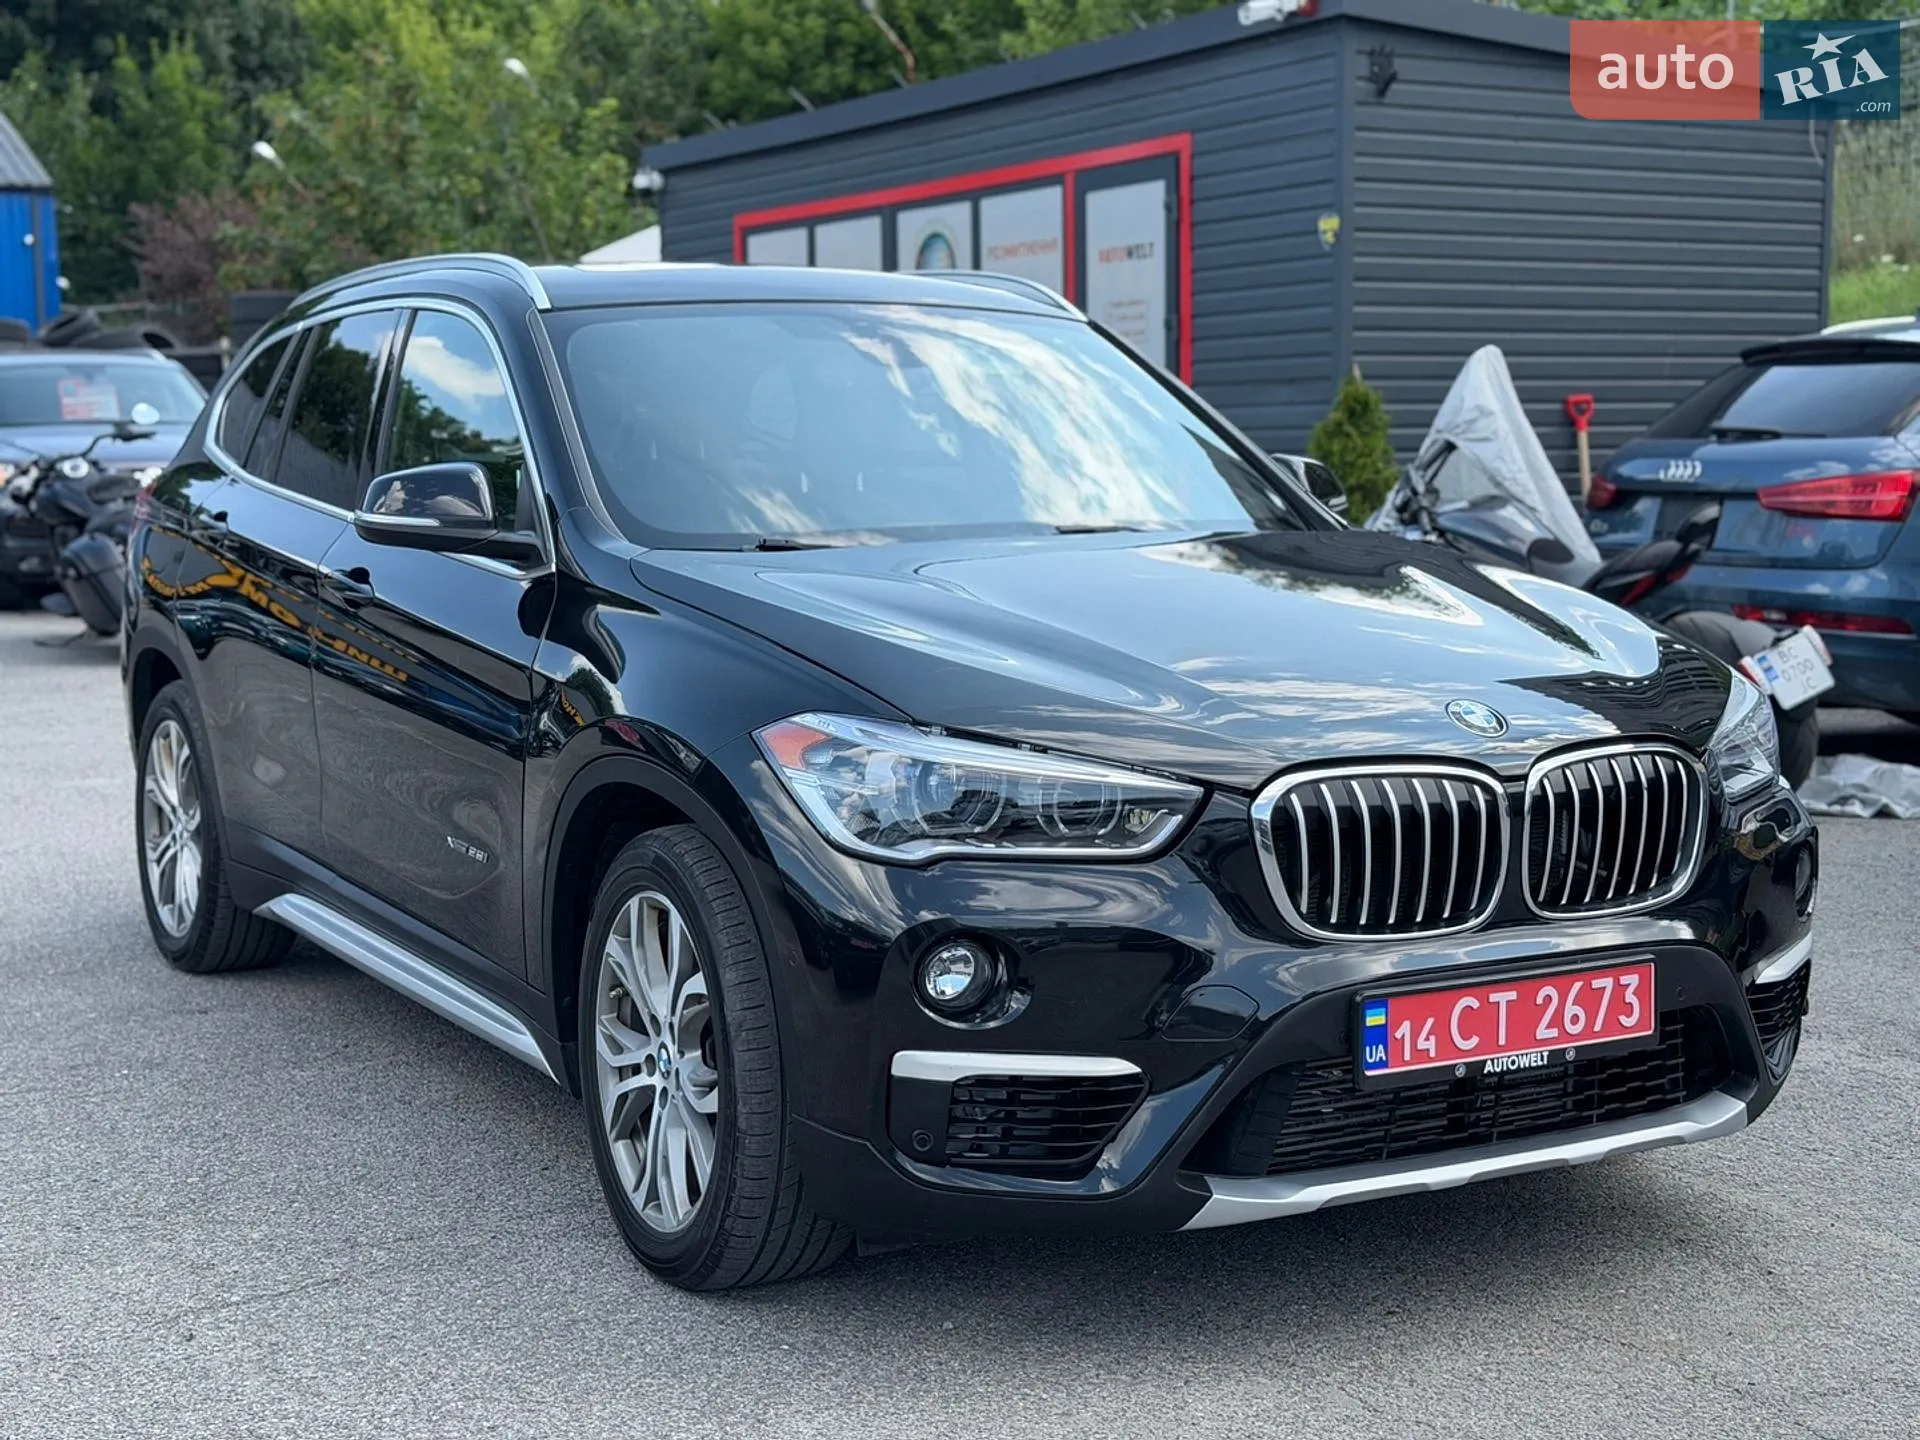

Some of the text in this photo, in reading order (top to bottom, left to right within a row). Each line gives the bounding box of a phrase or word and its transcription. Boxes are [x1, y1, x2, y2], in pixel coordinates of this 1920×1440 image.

[1449, 991, 1517, 1050] CT
[1535, 974, 1640, 1040] 2673
[1365, 1044, 1387, 1064] UA
[1483, 1051, 1550, 1075] AUTOWELT
